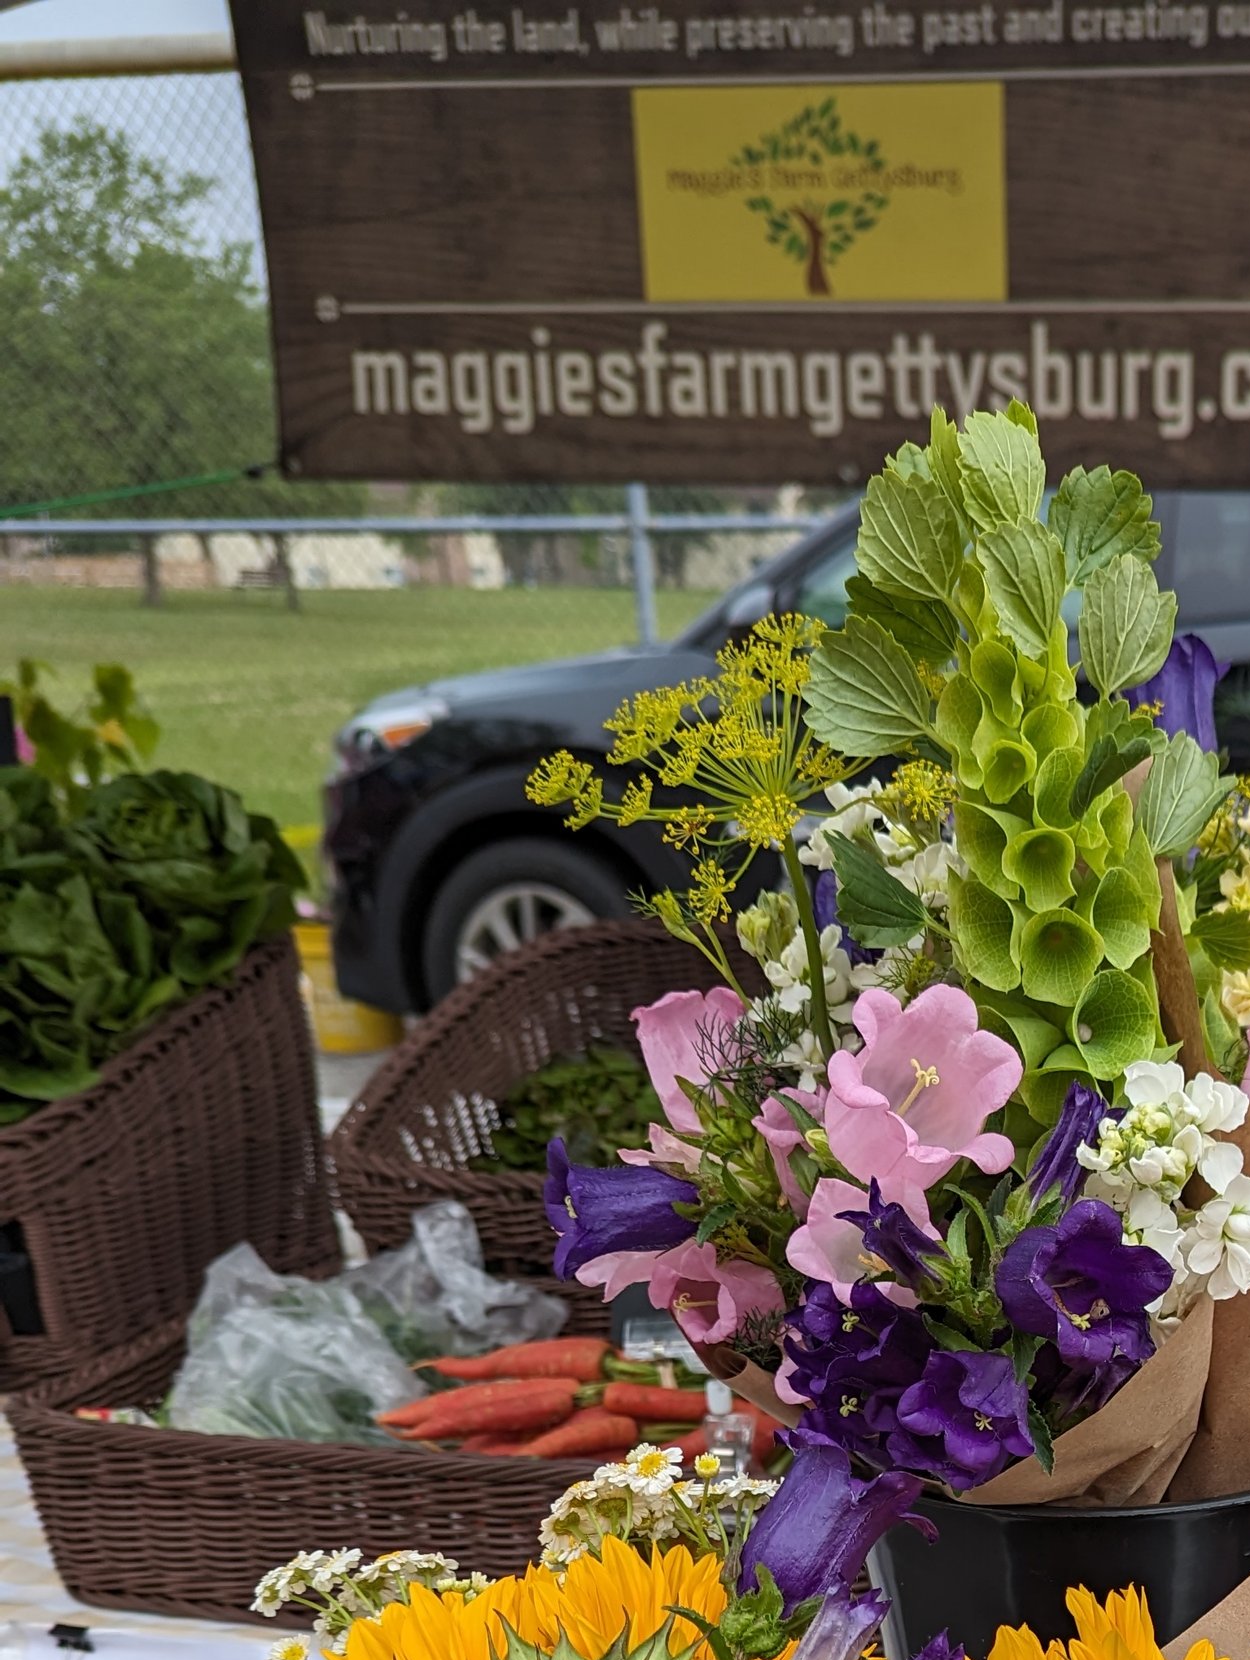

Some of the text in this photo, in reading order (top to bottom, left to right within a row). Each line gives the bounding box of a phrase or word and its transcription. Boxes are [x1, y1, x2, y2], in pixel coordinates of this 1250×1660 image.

[303, 9, 449, 61] Nurturing
[452, 9, 507, 53] the
[511, 8, 590, 57] land,
[595, 7, 679, 52] while
[685, 5, 856, 58] preserving
[861, 3, 914, 47] the
[922, 6, 999, 54] past
[1004, 1, 1064, 43] and
[1070, 0, 1208, 48] creating
